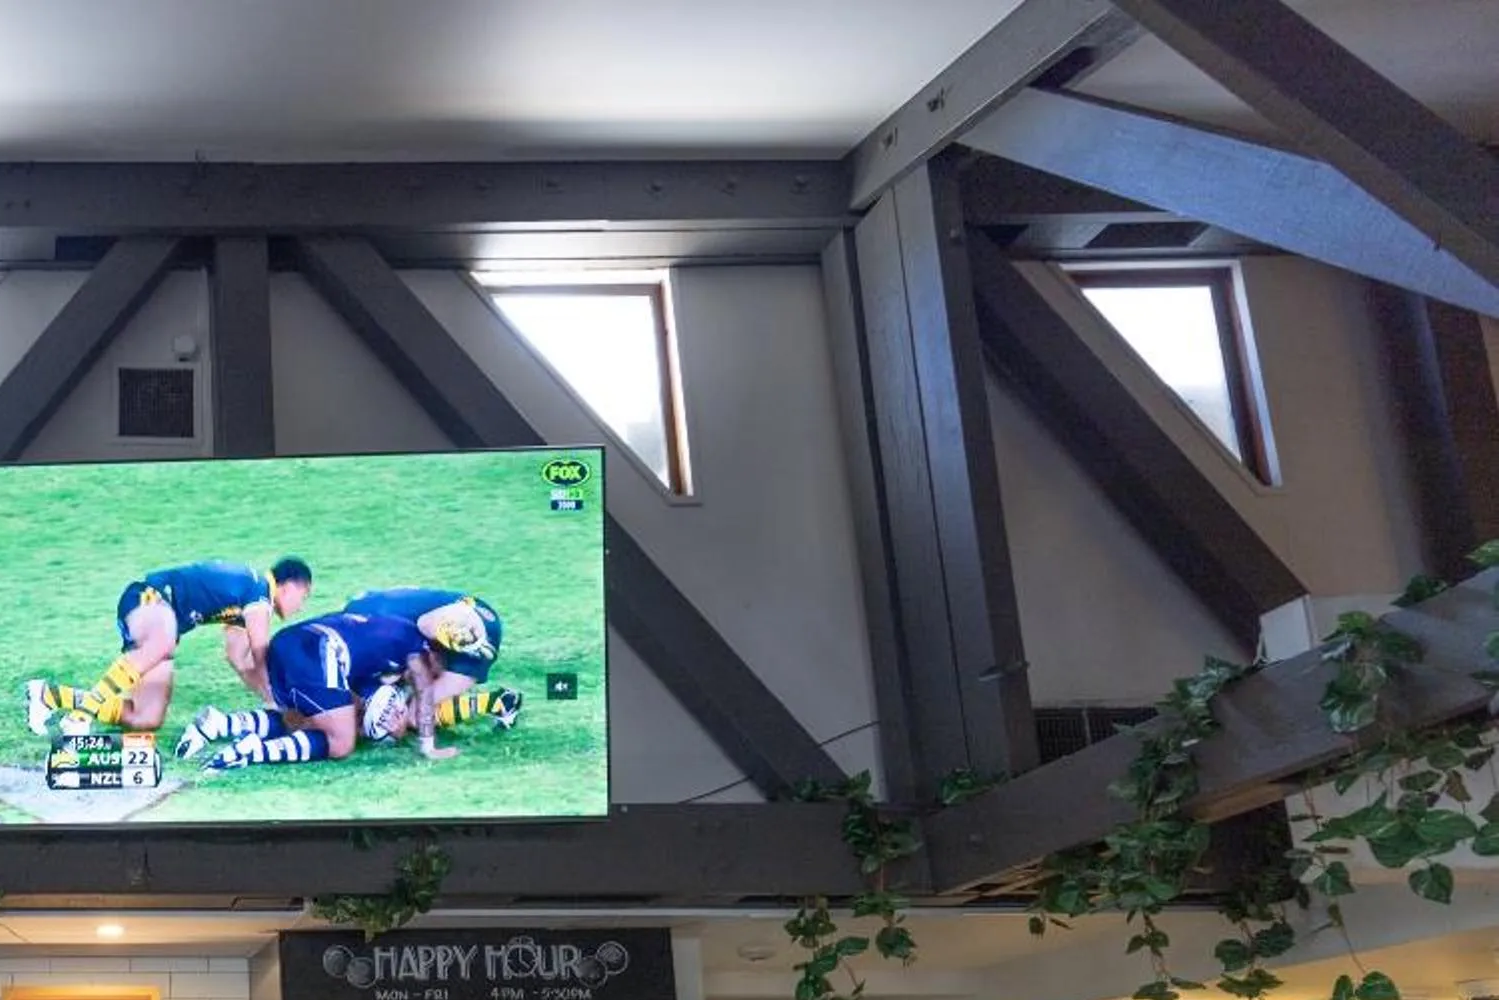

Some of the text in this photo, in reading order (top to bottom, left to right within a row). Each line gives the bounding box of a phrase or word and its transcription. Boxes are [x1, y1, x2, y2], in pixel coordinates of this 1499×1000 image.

[550, 465, 582, 480] FOX
[88, 751, 148, 766] AUS 22
[91, 771, 143, 785] NZL 6
[373, 940, 582, 981] HAPPY HOUR
[375, 989, 408, 1000] MON
[424, 988, 449, 1000] FRI
